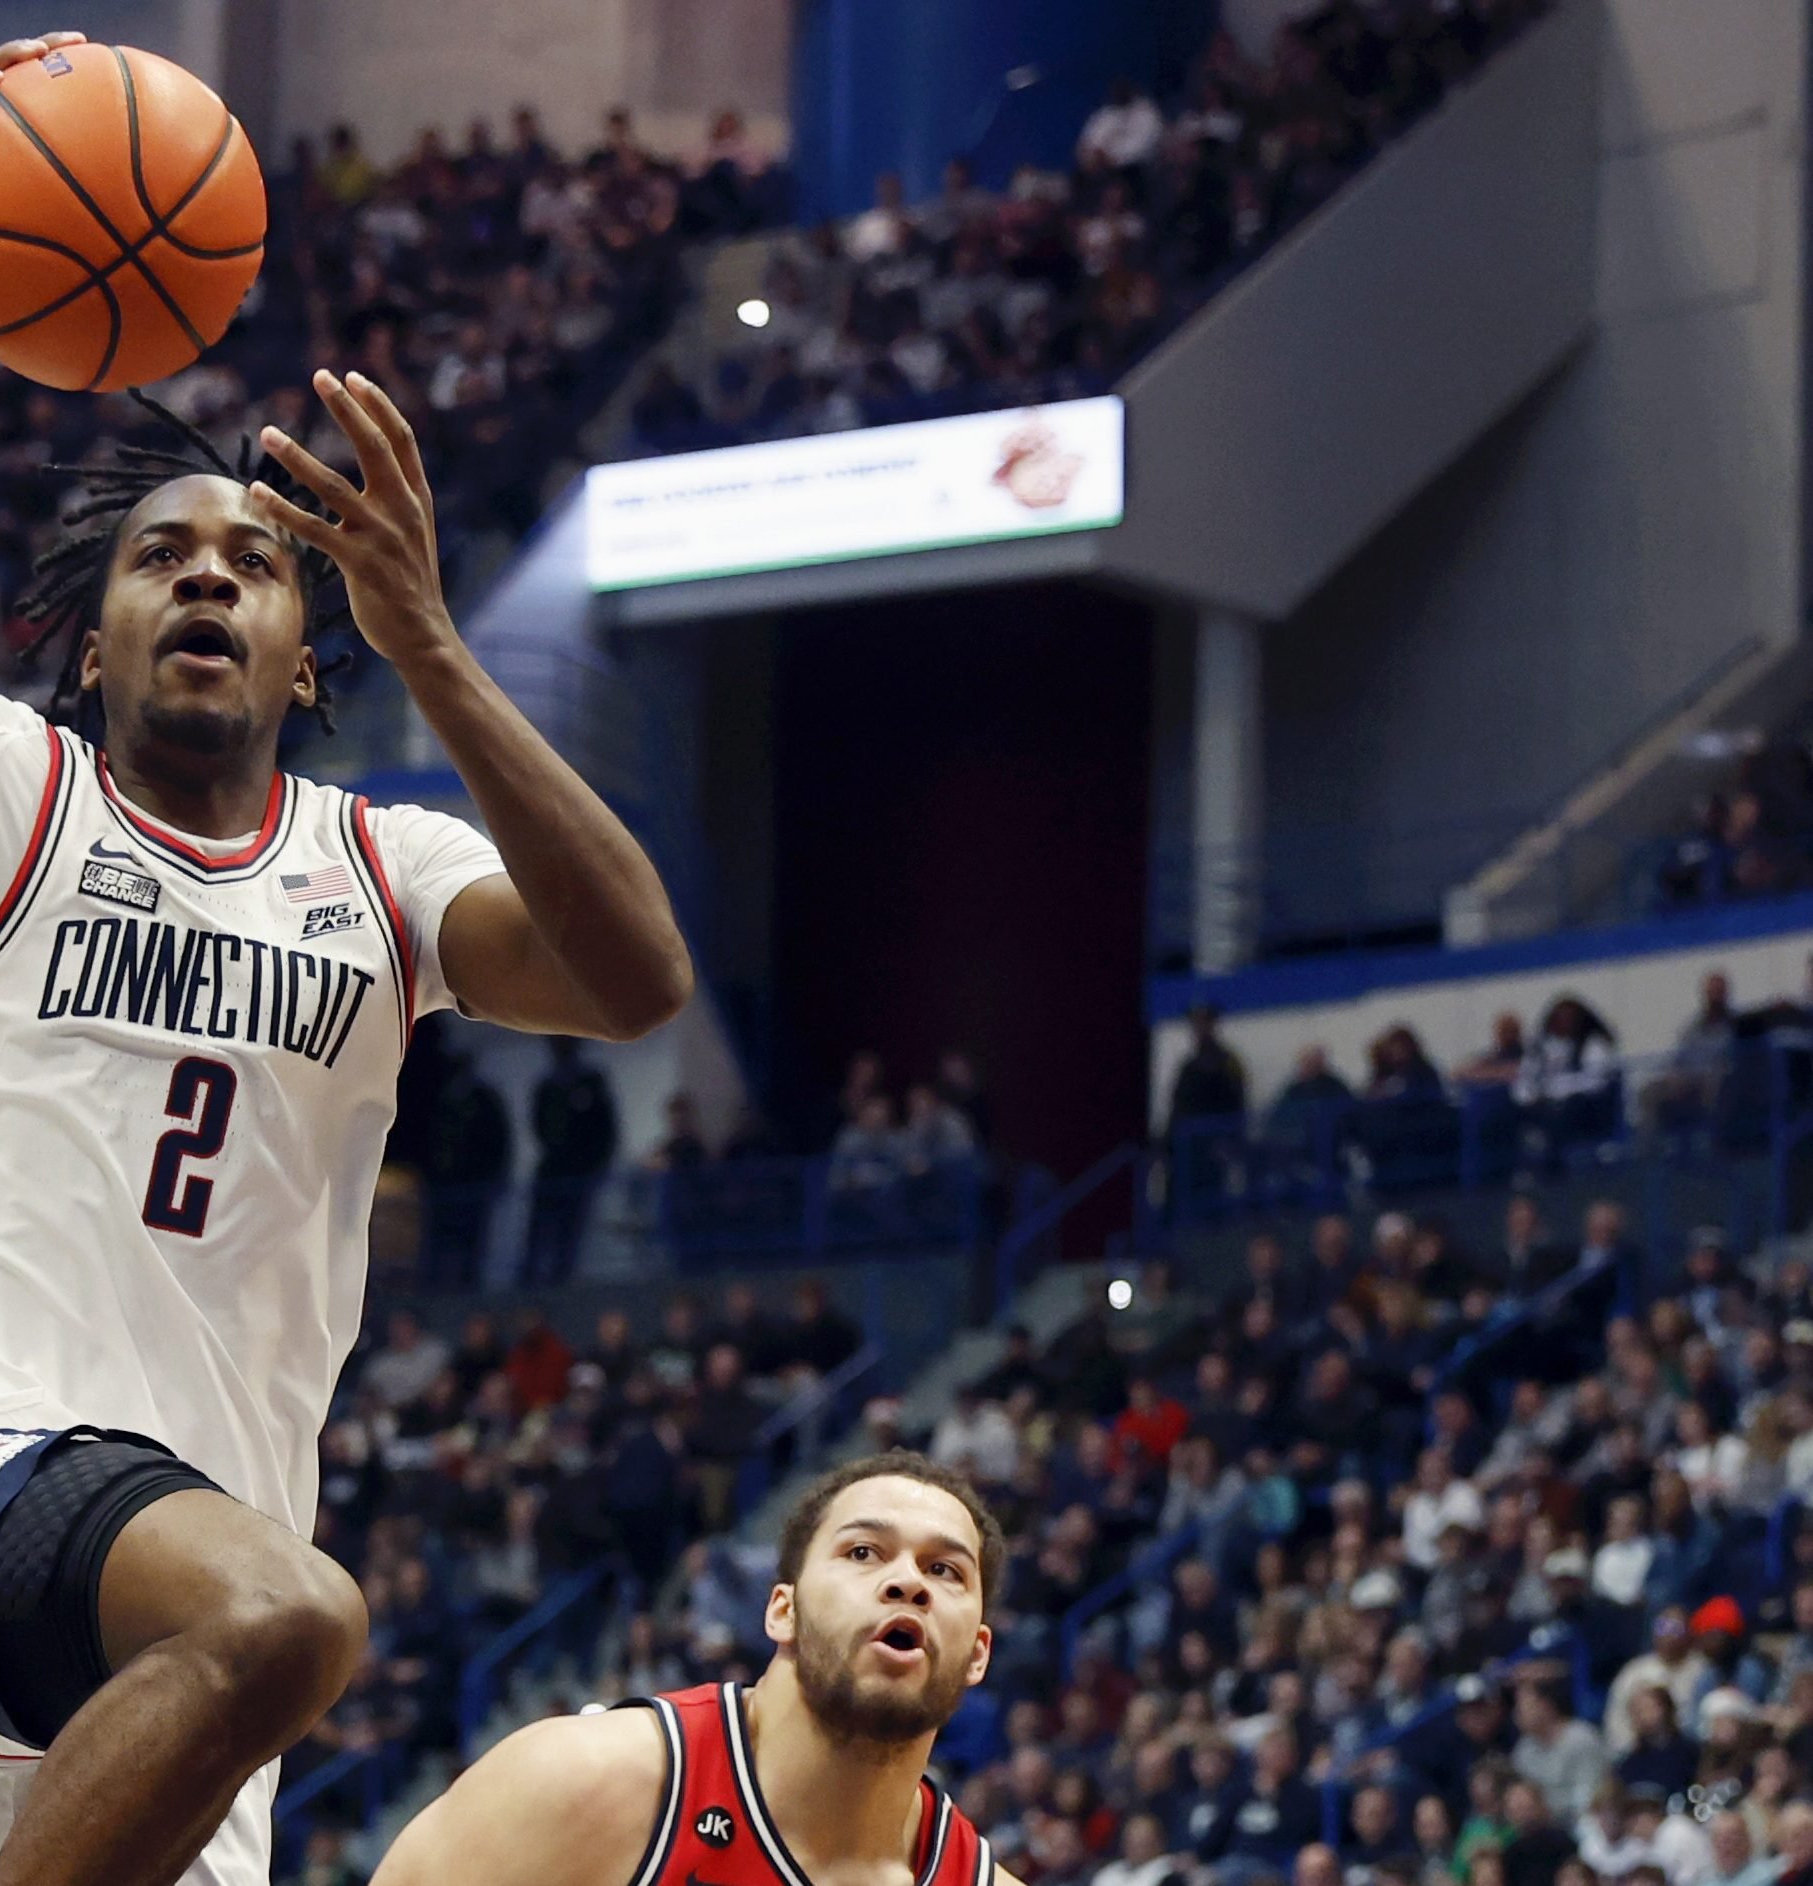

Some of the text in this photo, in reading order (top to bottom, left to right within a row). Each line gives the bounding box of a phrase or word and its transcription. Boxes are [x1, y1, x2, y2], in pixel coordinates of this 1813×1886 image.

[81, 878, 156, 909] CHANGE
[301, 911, 365, 935] EAST
[305, 902, 350, 922] BIG
[37, 918, 375, 1069] CONNECTICUT
[142, 1056, 237, 1238] 2
[697, 1813, 732, 1841] JK
